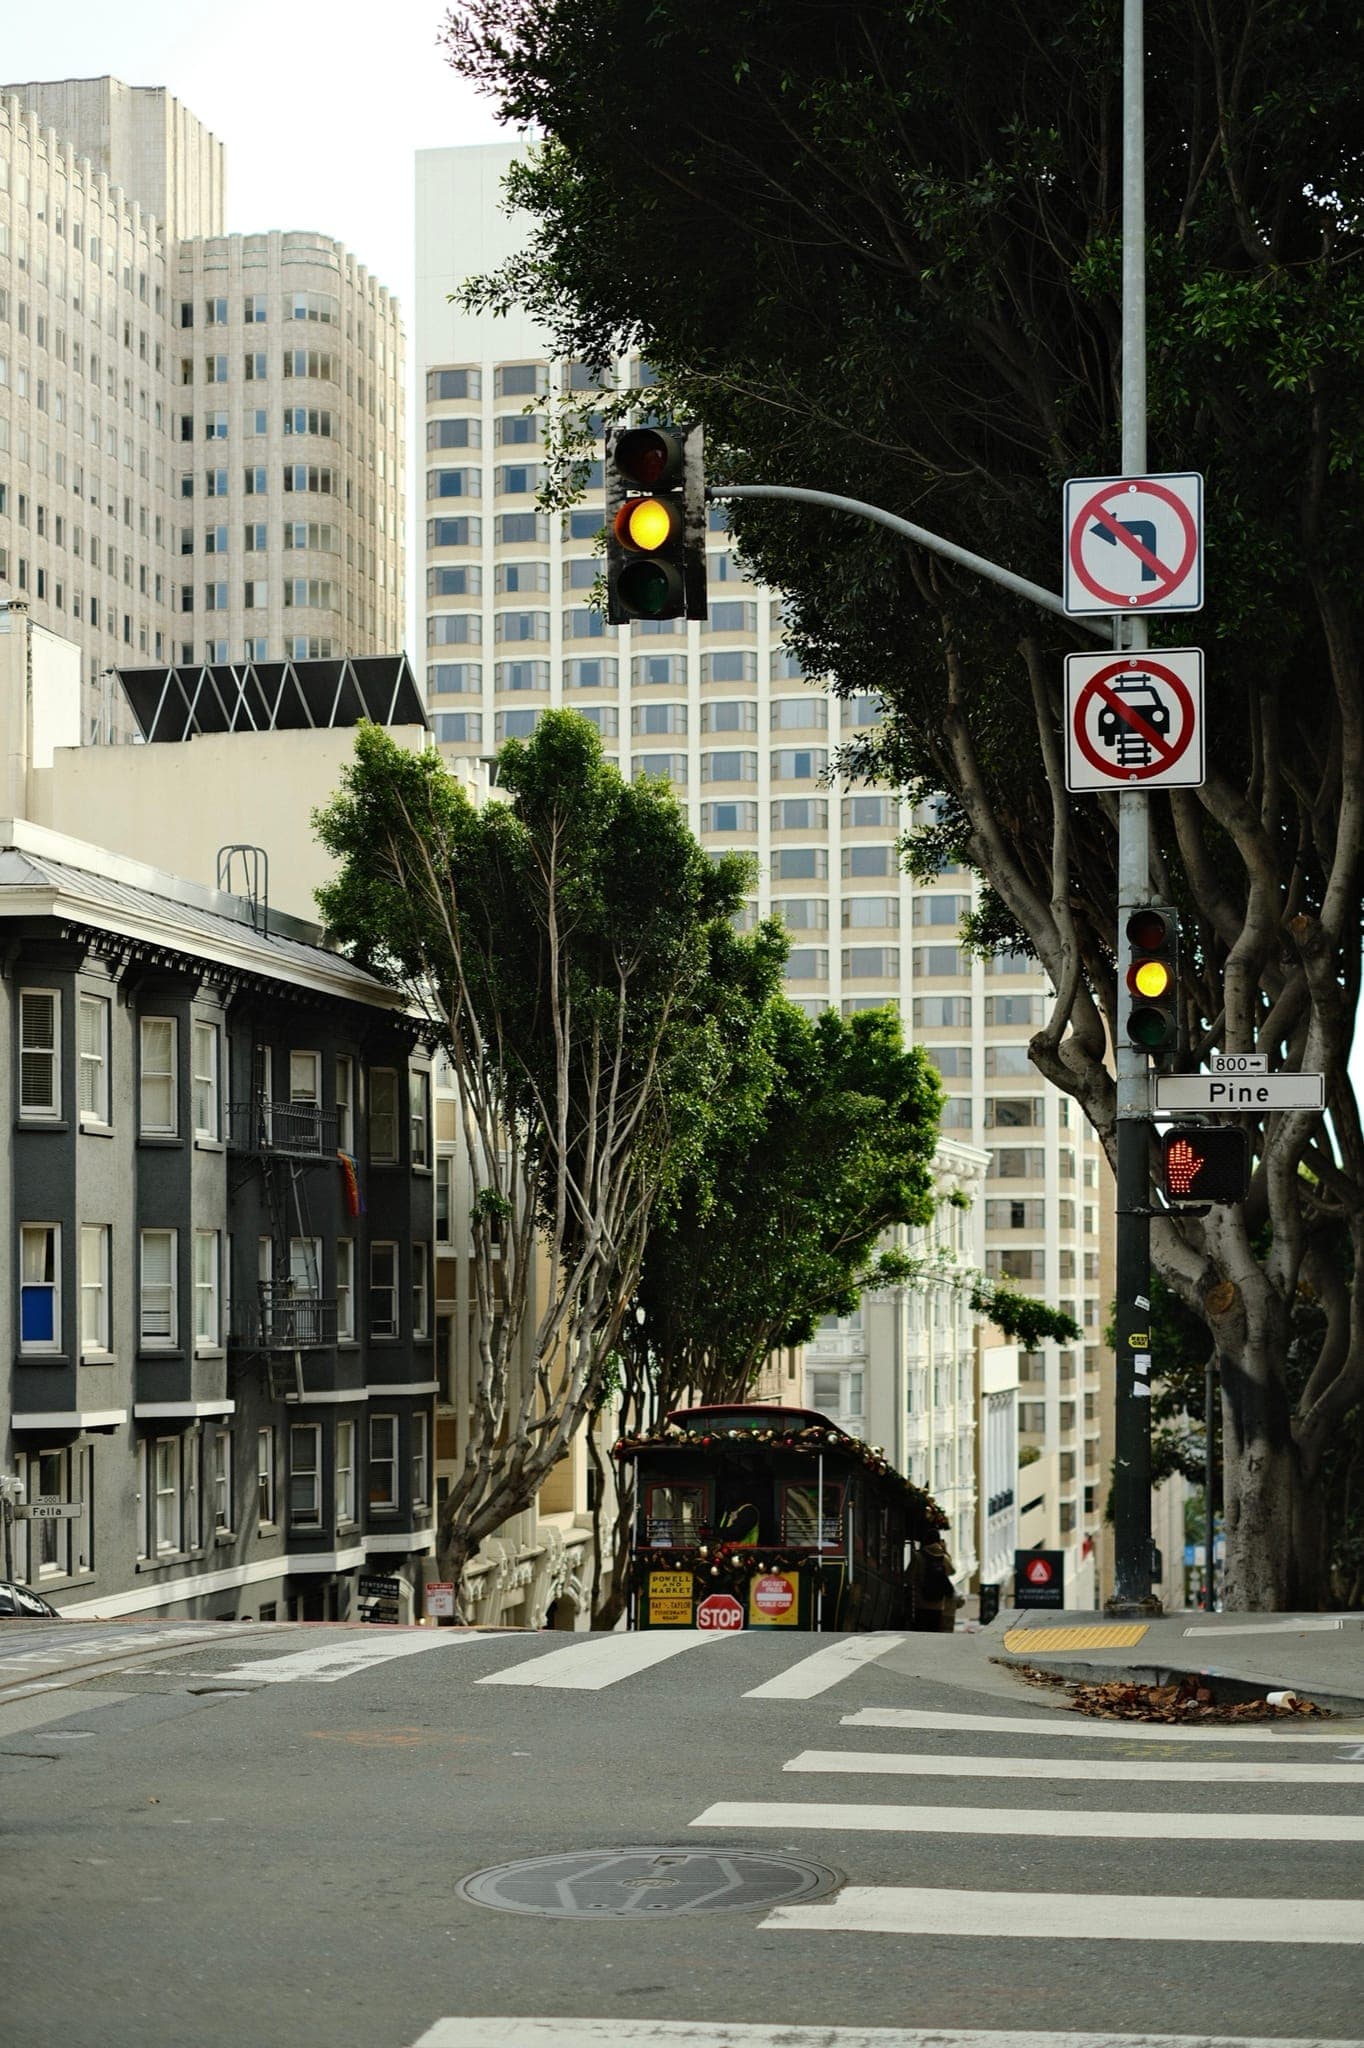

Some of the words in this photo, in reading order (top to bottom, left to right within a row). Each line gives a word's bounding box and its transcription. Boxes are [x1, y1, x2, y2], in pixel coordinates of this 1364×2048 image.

[1216, 1058, 1247, 1071] 800
[1209, 1083, 1269, 1102] Pine
[32, 1507, 62, 1516] Fella
[773, 1580, 787, 1588] NOT
[700, 1608, 741, 1627] STOP
